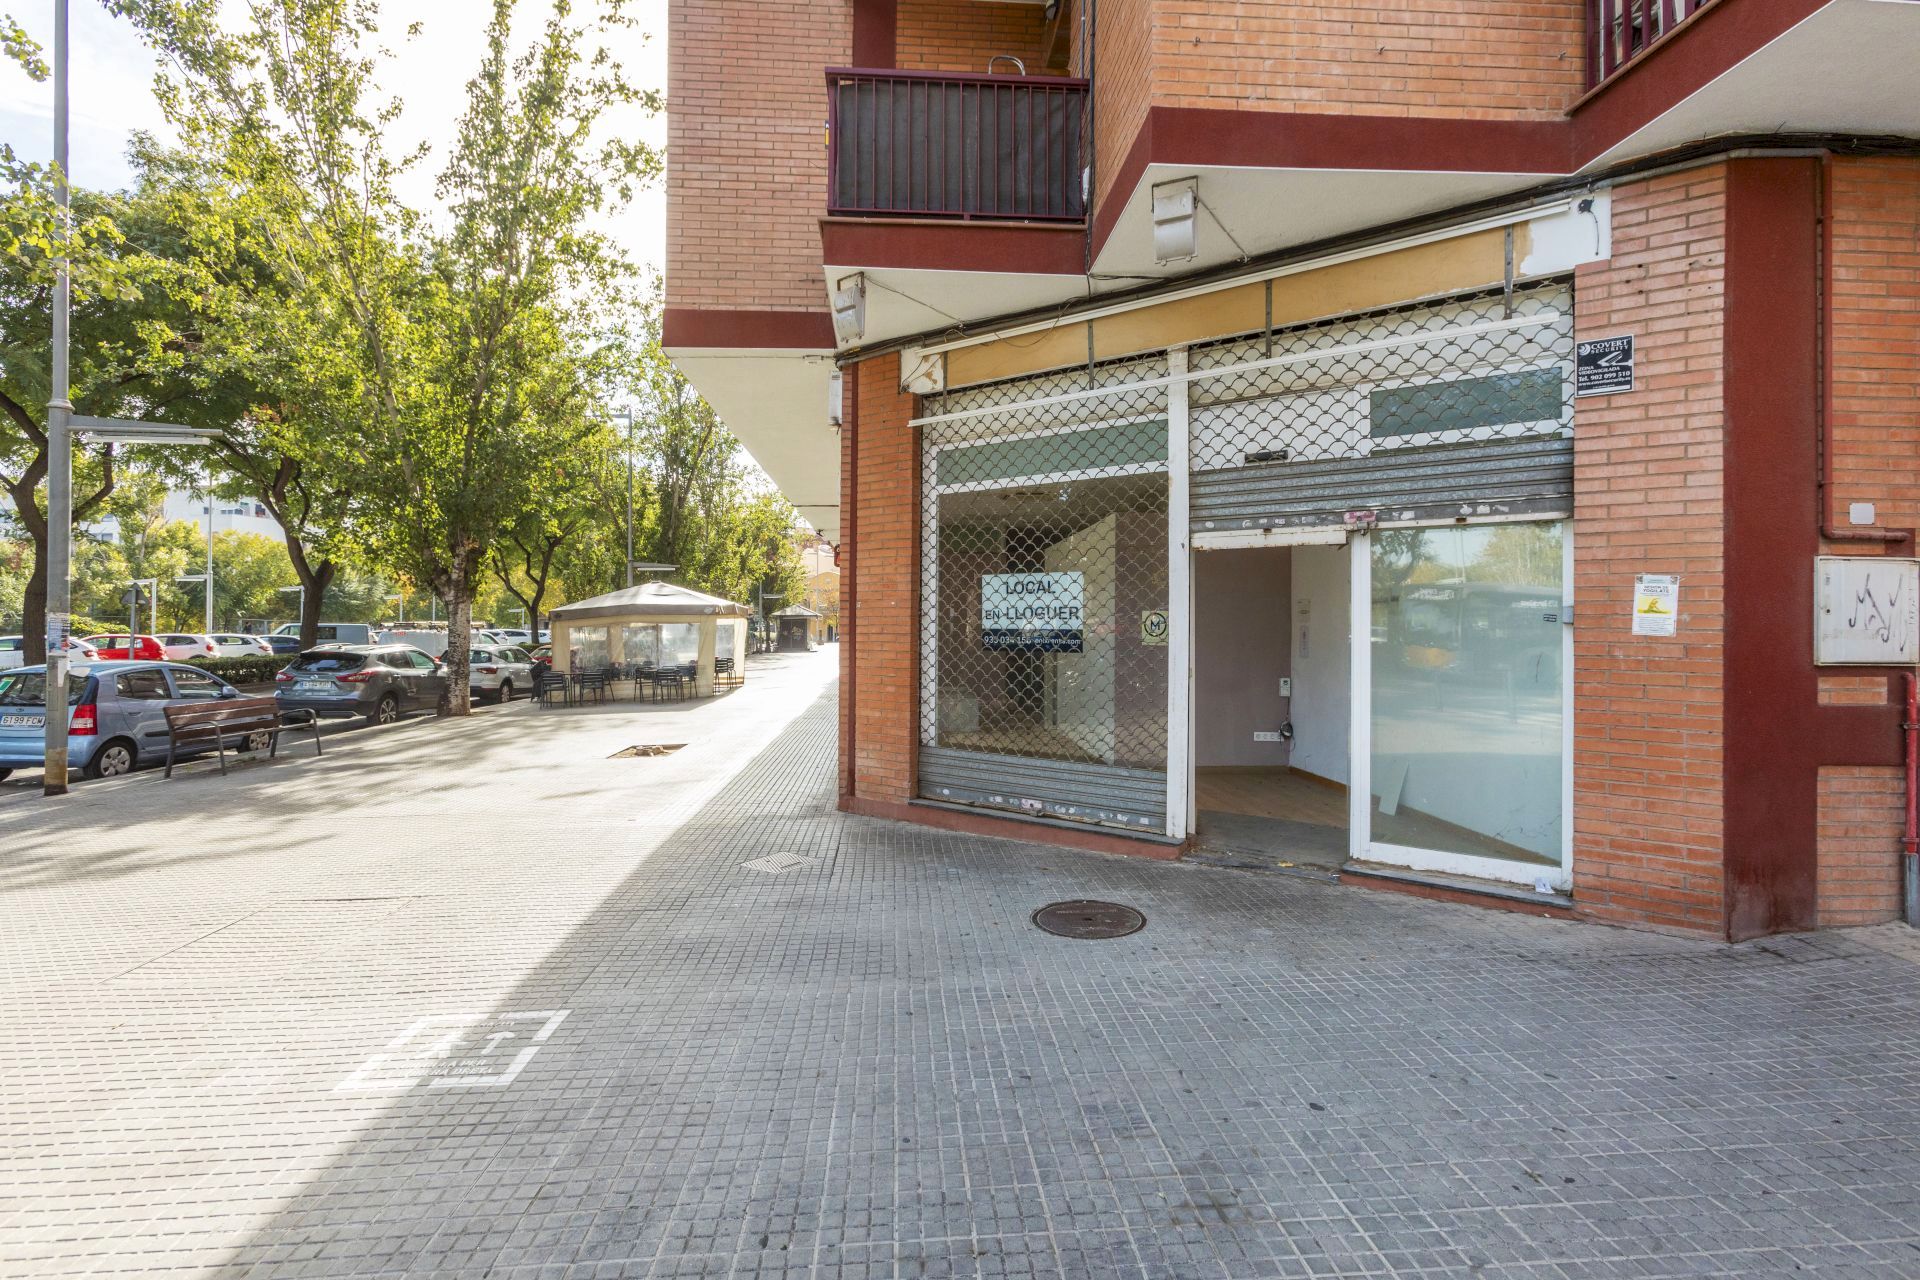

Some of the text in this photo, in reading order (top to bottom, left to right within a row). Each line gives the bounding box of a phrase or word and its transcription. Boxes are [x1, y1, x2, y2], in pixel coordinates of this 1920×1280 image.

[1591, 339, 1628, 350] COVERT
[1591, 346, 1628, 354] SECURITY
[1578, 366, 1620, 375] VIDEOVIGILADA
[1006, 580, 1056, 595] LOCAL
[985, 606, 1079, 620] EN LLOGUER
[1150, 619, 1161, 631] M
